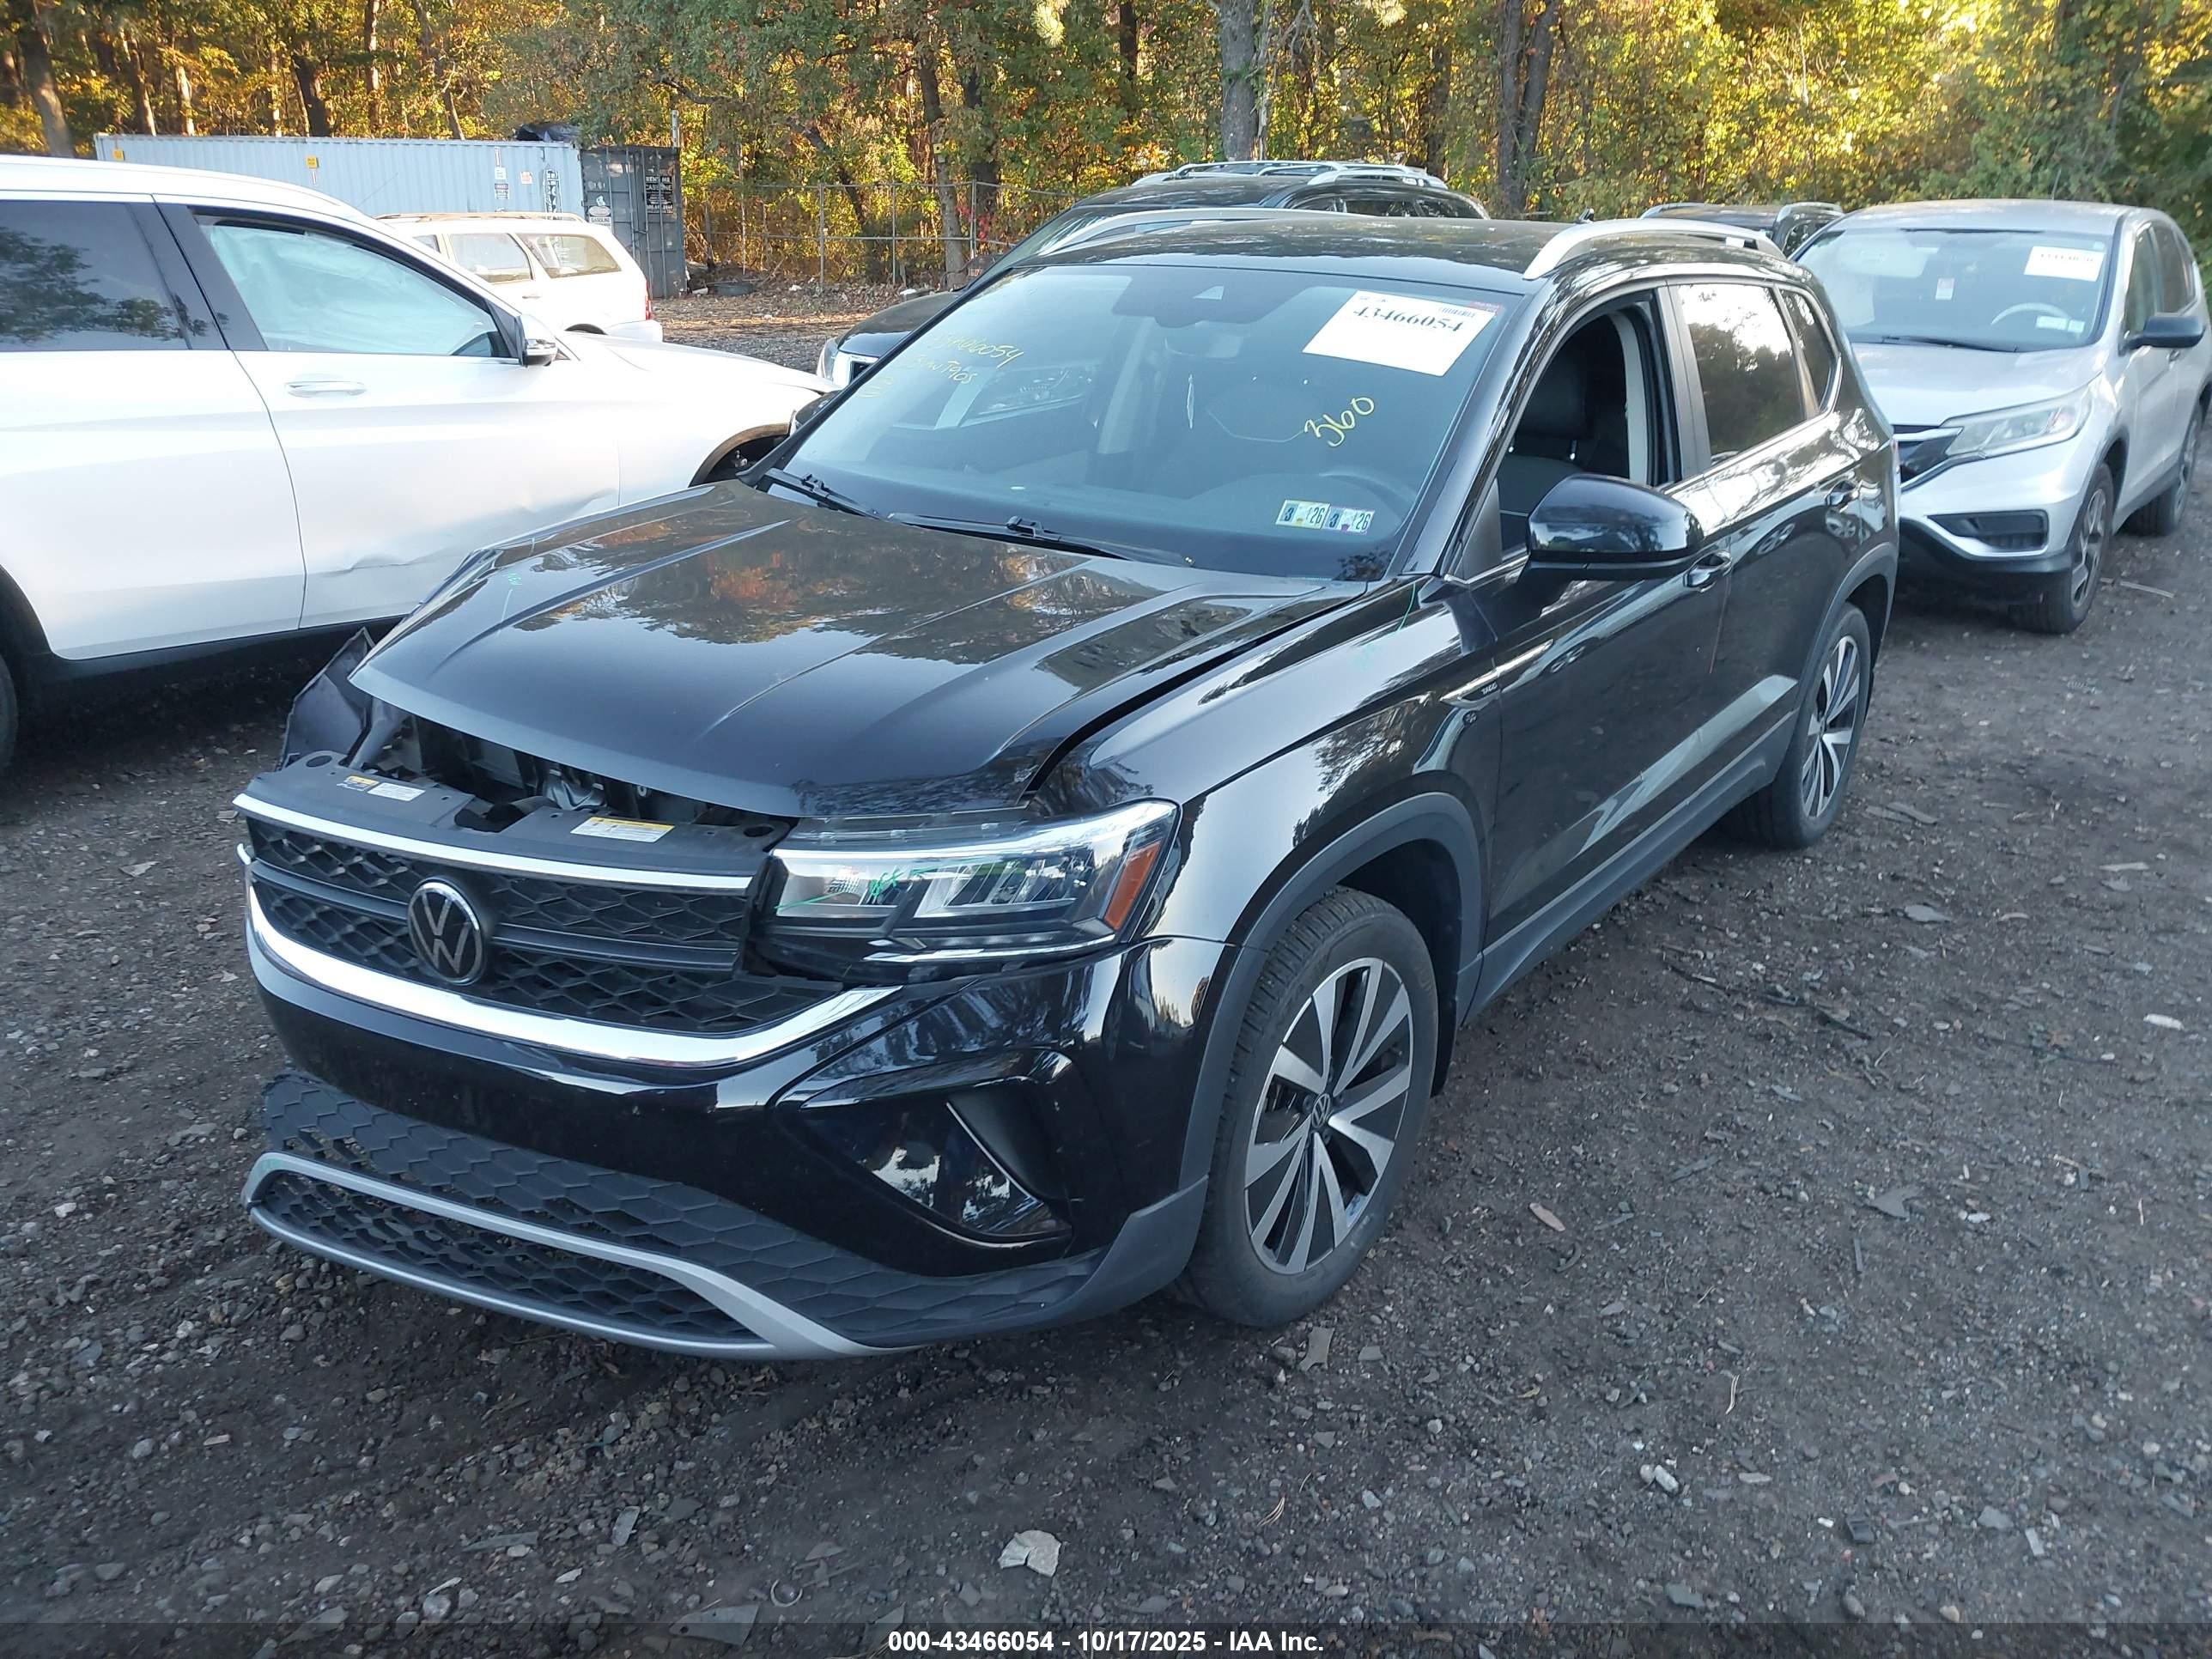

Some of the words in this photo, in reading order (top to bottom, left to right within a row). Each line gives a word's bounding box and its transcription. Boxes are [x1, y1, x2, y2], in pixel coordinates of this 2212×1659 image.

[1352, 307, 1464, 331] 43466054
[1304, 397, 1375, 447] 360
[1284, 507, 1295, 522] 3
[1310, 507, 1326, 525] 26
[1329, 513, 1340, 528] 3
[1355, 513, 1371, 531] 26
[410, 884, 478, 980] VW
